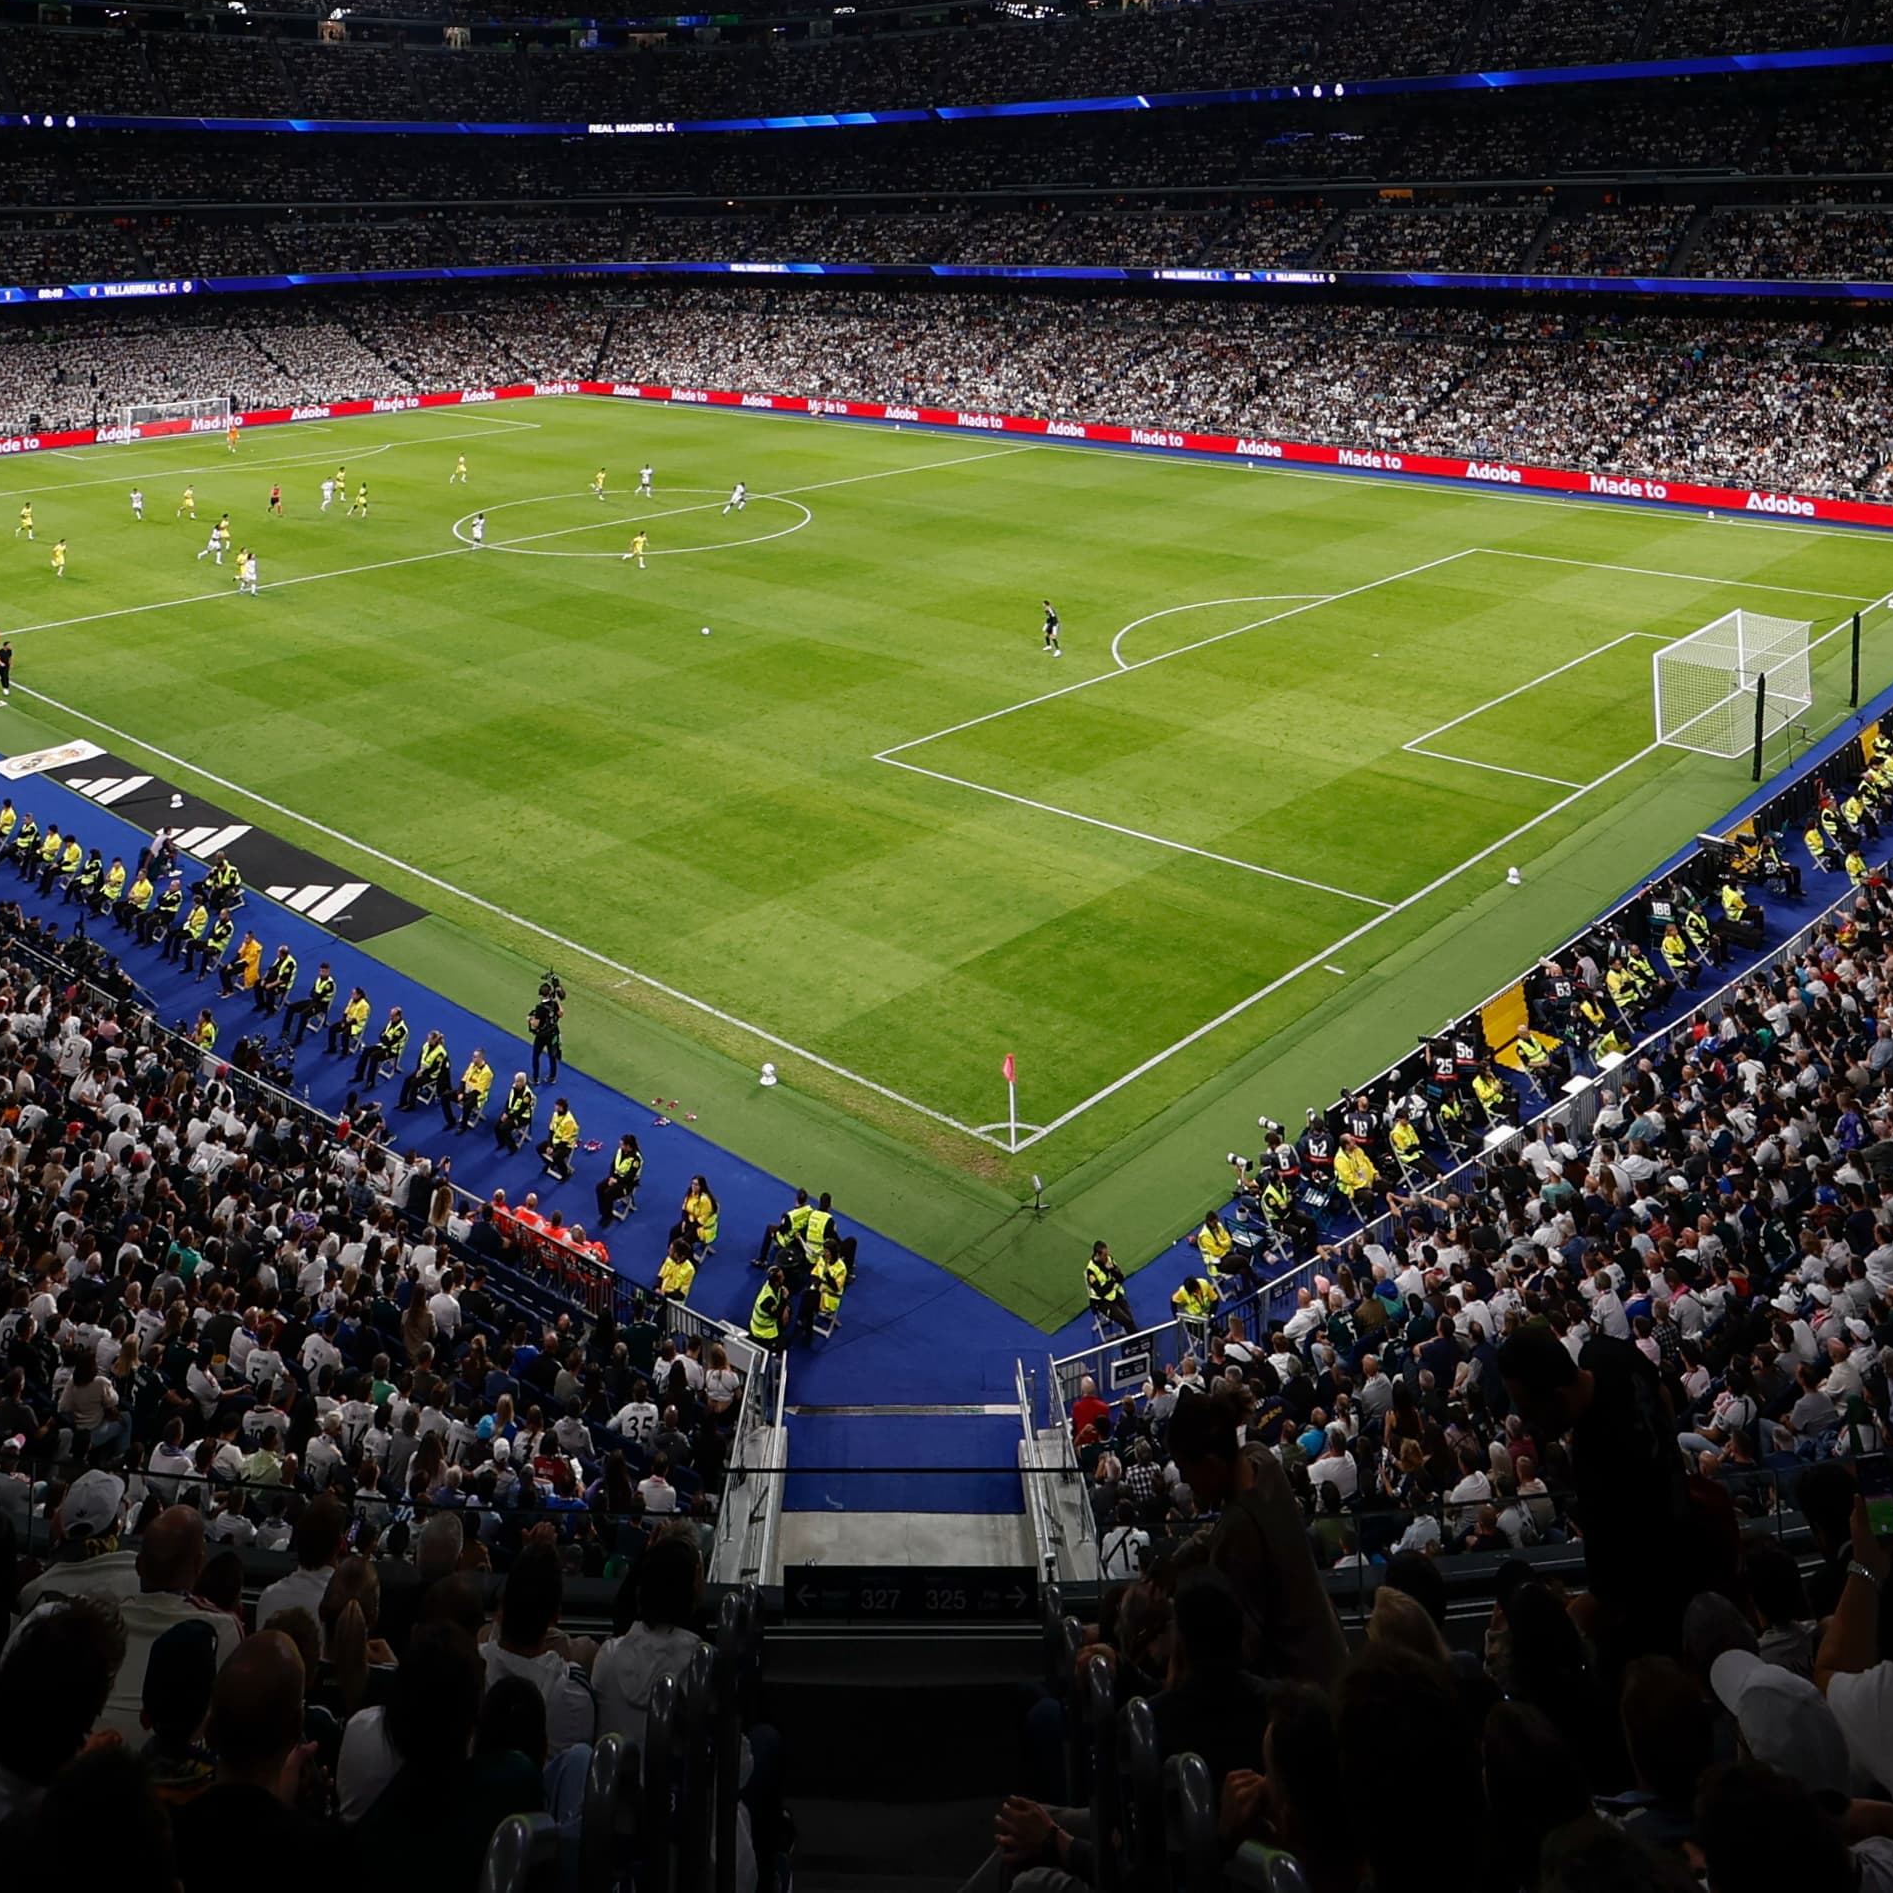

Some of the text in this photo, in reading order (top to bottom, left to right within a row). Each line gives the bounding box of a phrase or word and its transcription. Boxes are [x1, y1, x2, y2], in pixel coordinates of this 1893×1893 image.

[588, 124, 614, 133] REAL
[616, 123, 654, 133] MADRID
[104, 284, 158, 296] VILLARREAL
[461, 389, 495, 403] Adobe
[534, 384, 564, 396] Made
[613, 385, 640, 397] Adobe
[671, 388, 696, 400] Made
[741, 395, 772, 408] Adobe
[291, 407, 330, 420] Adobe
[885, 406, 918, 420] Adobe
[958, 413, 1003, 428] Made to
[96, 425, 140, 442] Adobe
[1047, 421, 1084, 436] Adobe
[22, 436, 39, 449] to
[1130, 430, 1183, 447] Made to
[1236, 440, 1282, 458] Adobe
[1338, 449, 1402, 468] Made to
[1466, 462, 1521, 483] Adobe
[1590, 475, 1666, 499] Made to
[1745, 492, 1815, 515] Adobe
[1555, 982, 1571, 997] 63
[1436, 1058, 1453, 1075] 25
[628, 1416, 655, 1442] 35
[859, 1589, 901, 1611] 327
[924, 1589, 968, 1611] 325
